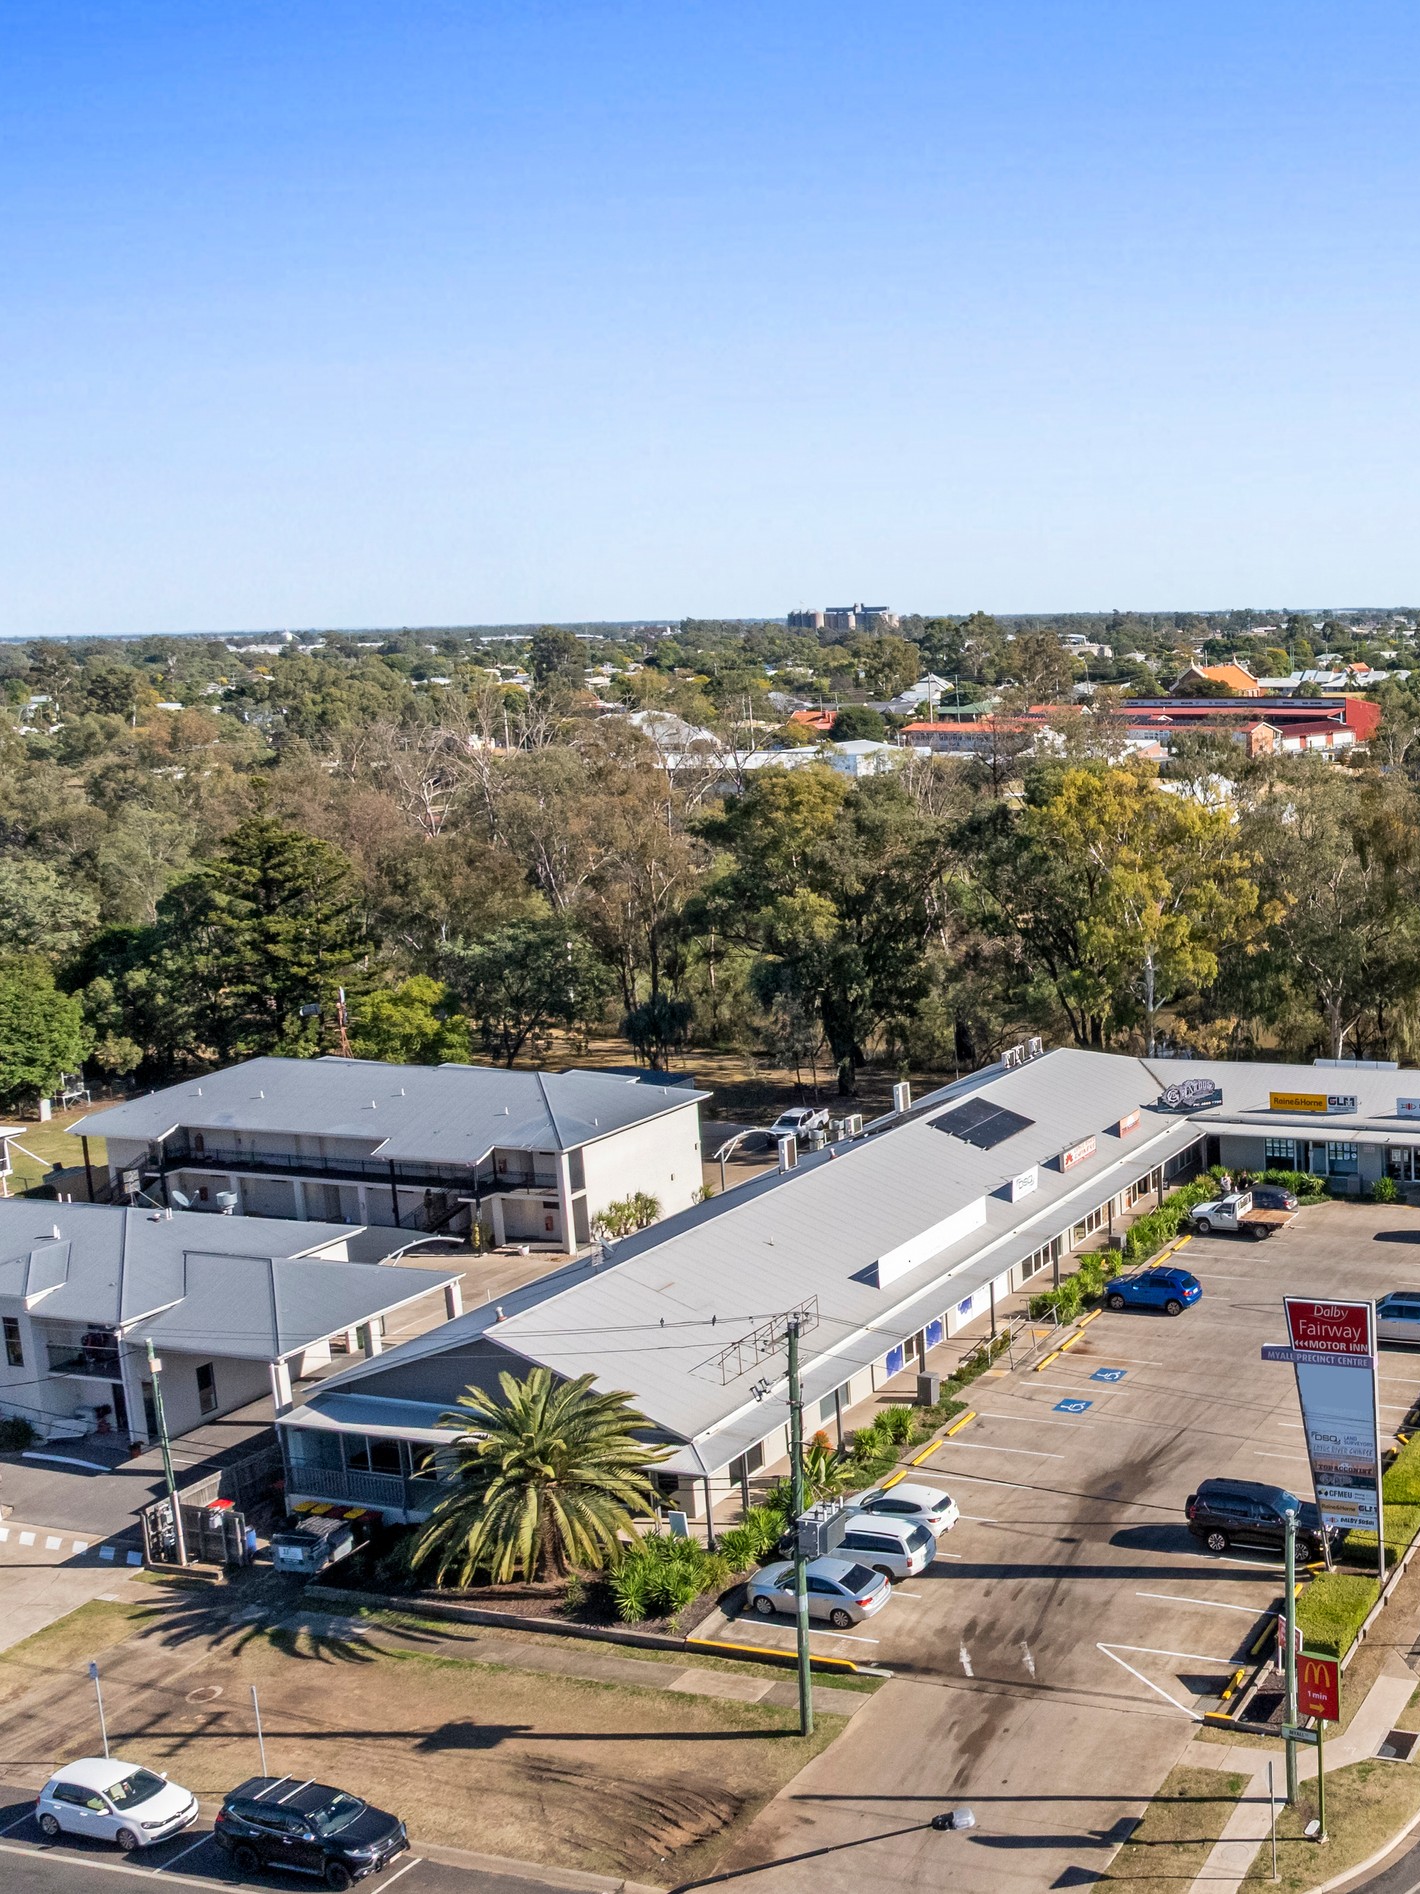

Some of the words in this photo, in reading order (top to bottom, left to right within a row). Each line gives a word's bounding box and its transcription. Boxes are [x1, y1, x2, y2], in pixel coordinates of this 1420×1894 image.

[1328, 1096, 1355, 1106] GLM
[1313, 1304, 1349, 1320] Dalby
[1299, 1320, 1361, 1342] Fairway
[1309, 1340, 1347, 1351] MOTOR
[1349, 1343, 1368, 1353] INN
[1267, 1351, 1294, 1360] MYALL
[1296, 1354, 1335, 1364] PRECINCT
[1337, 1357, 1368, 1367] CENTRE
[1329, 1489, 1353, 1498] CFMEU
[1313, 1691, 1328, 1701] min
